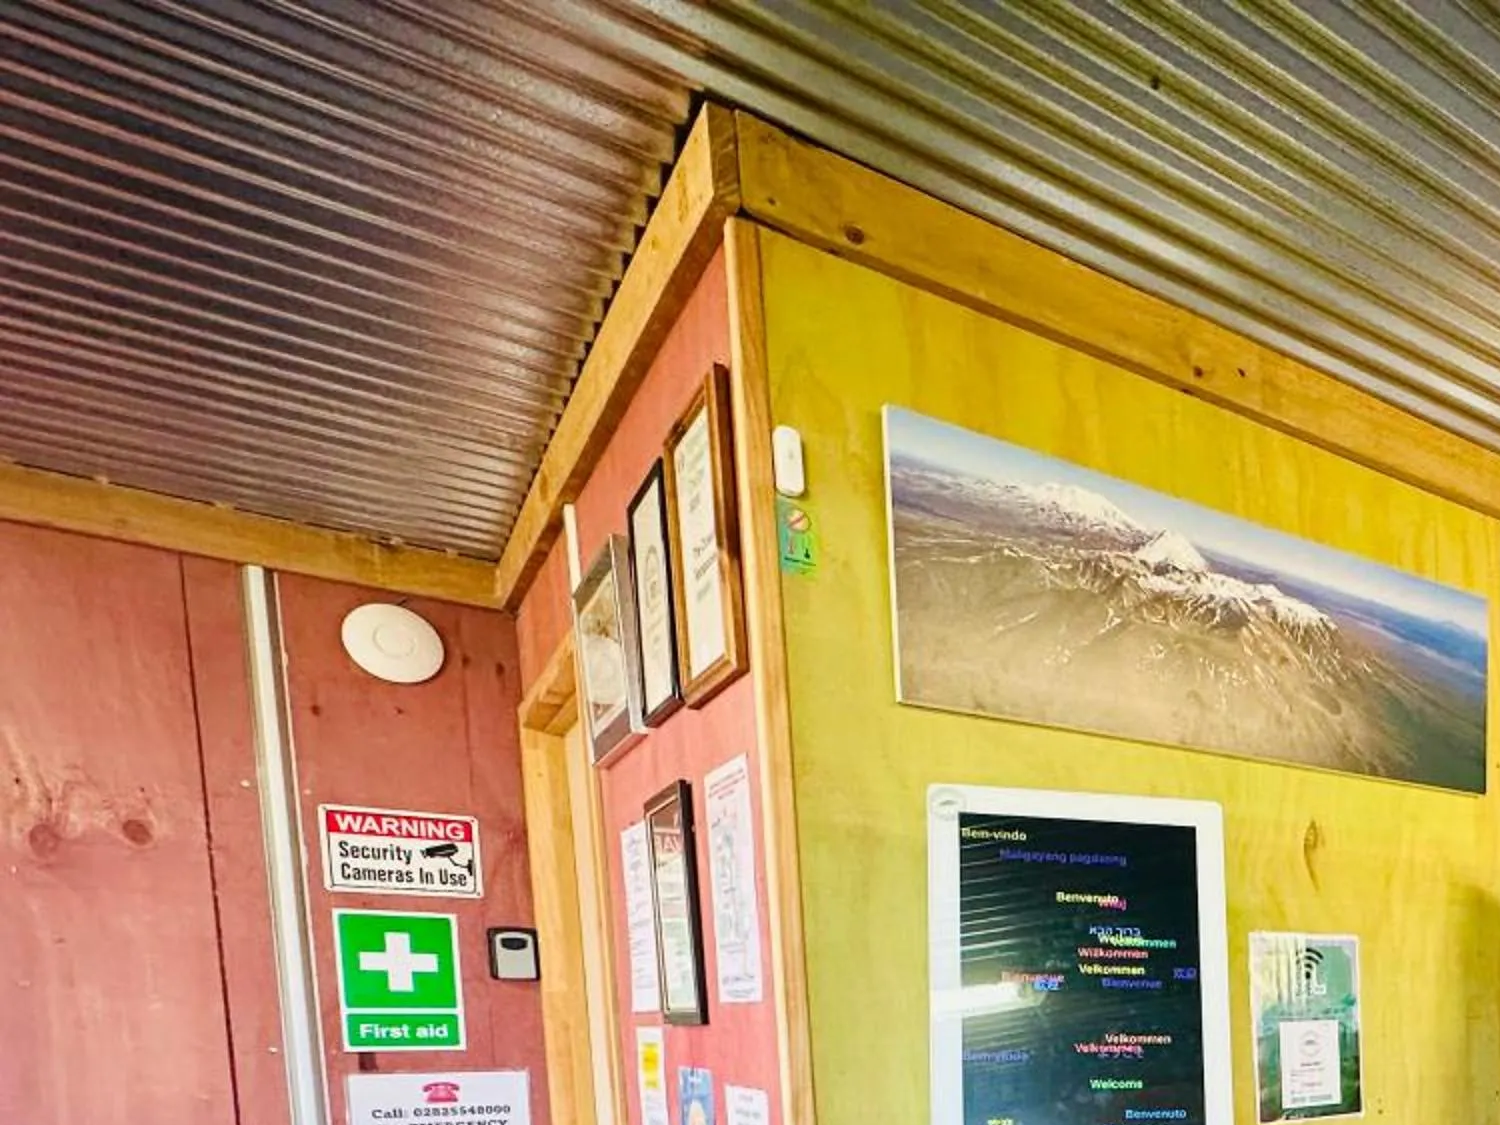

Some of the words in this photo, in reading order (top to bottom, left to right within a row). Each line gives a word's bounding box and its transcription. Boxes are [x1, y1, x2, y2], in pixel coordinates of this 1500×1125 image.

[334, 812, 466, 841] WARNING
[338, 841, 413, 865] Security
[340, 862, 414, 885] Cameras
[419, 867, 435, 885] In
[438, 868, 468, 888] Use
[1055, 891, 1119, 904] Benvenuto
[1078, 963, 1146, 976] Velkommen
[359, 1022, 409, 1039] First
[415, 1023, 449, 1039] aid
[1105, 1033, 1172, 1045] Velkommen
[1089, 1079, 1144, 1090] Welcome
[1125, 1108, 1187, 1120] Benvenuto
